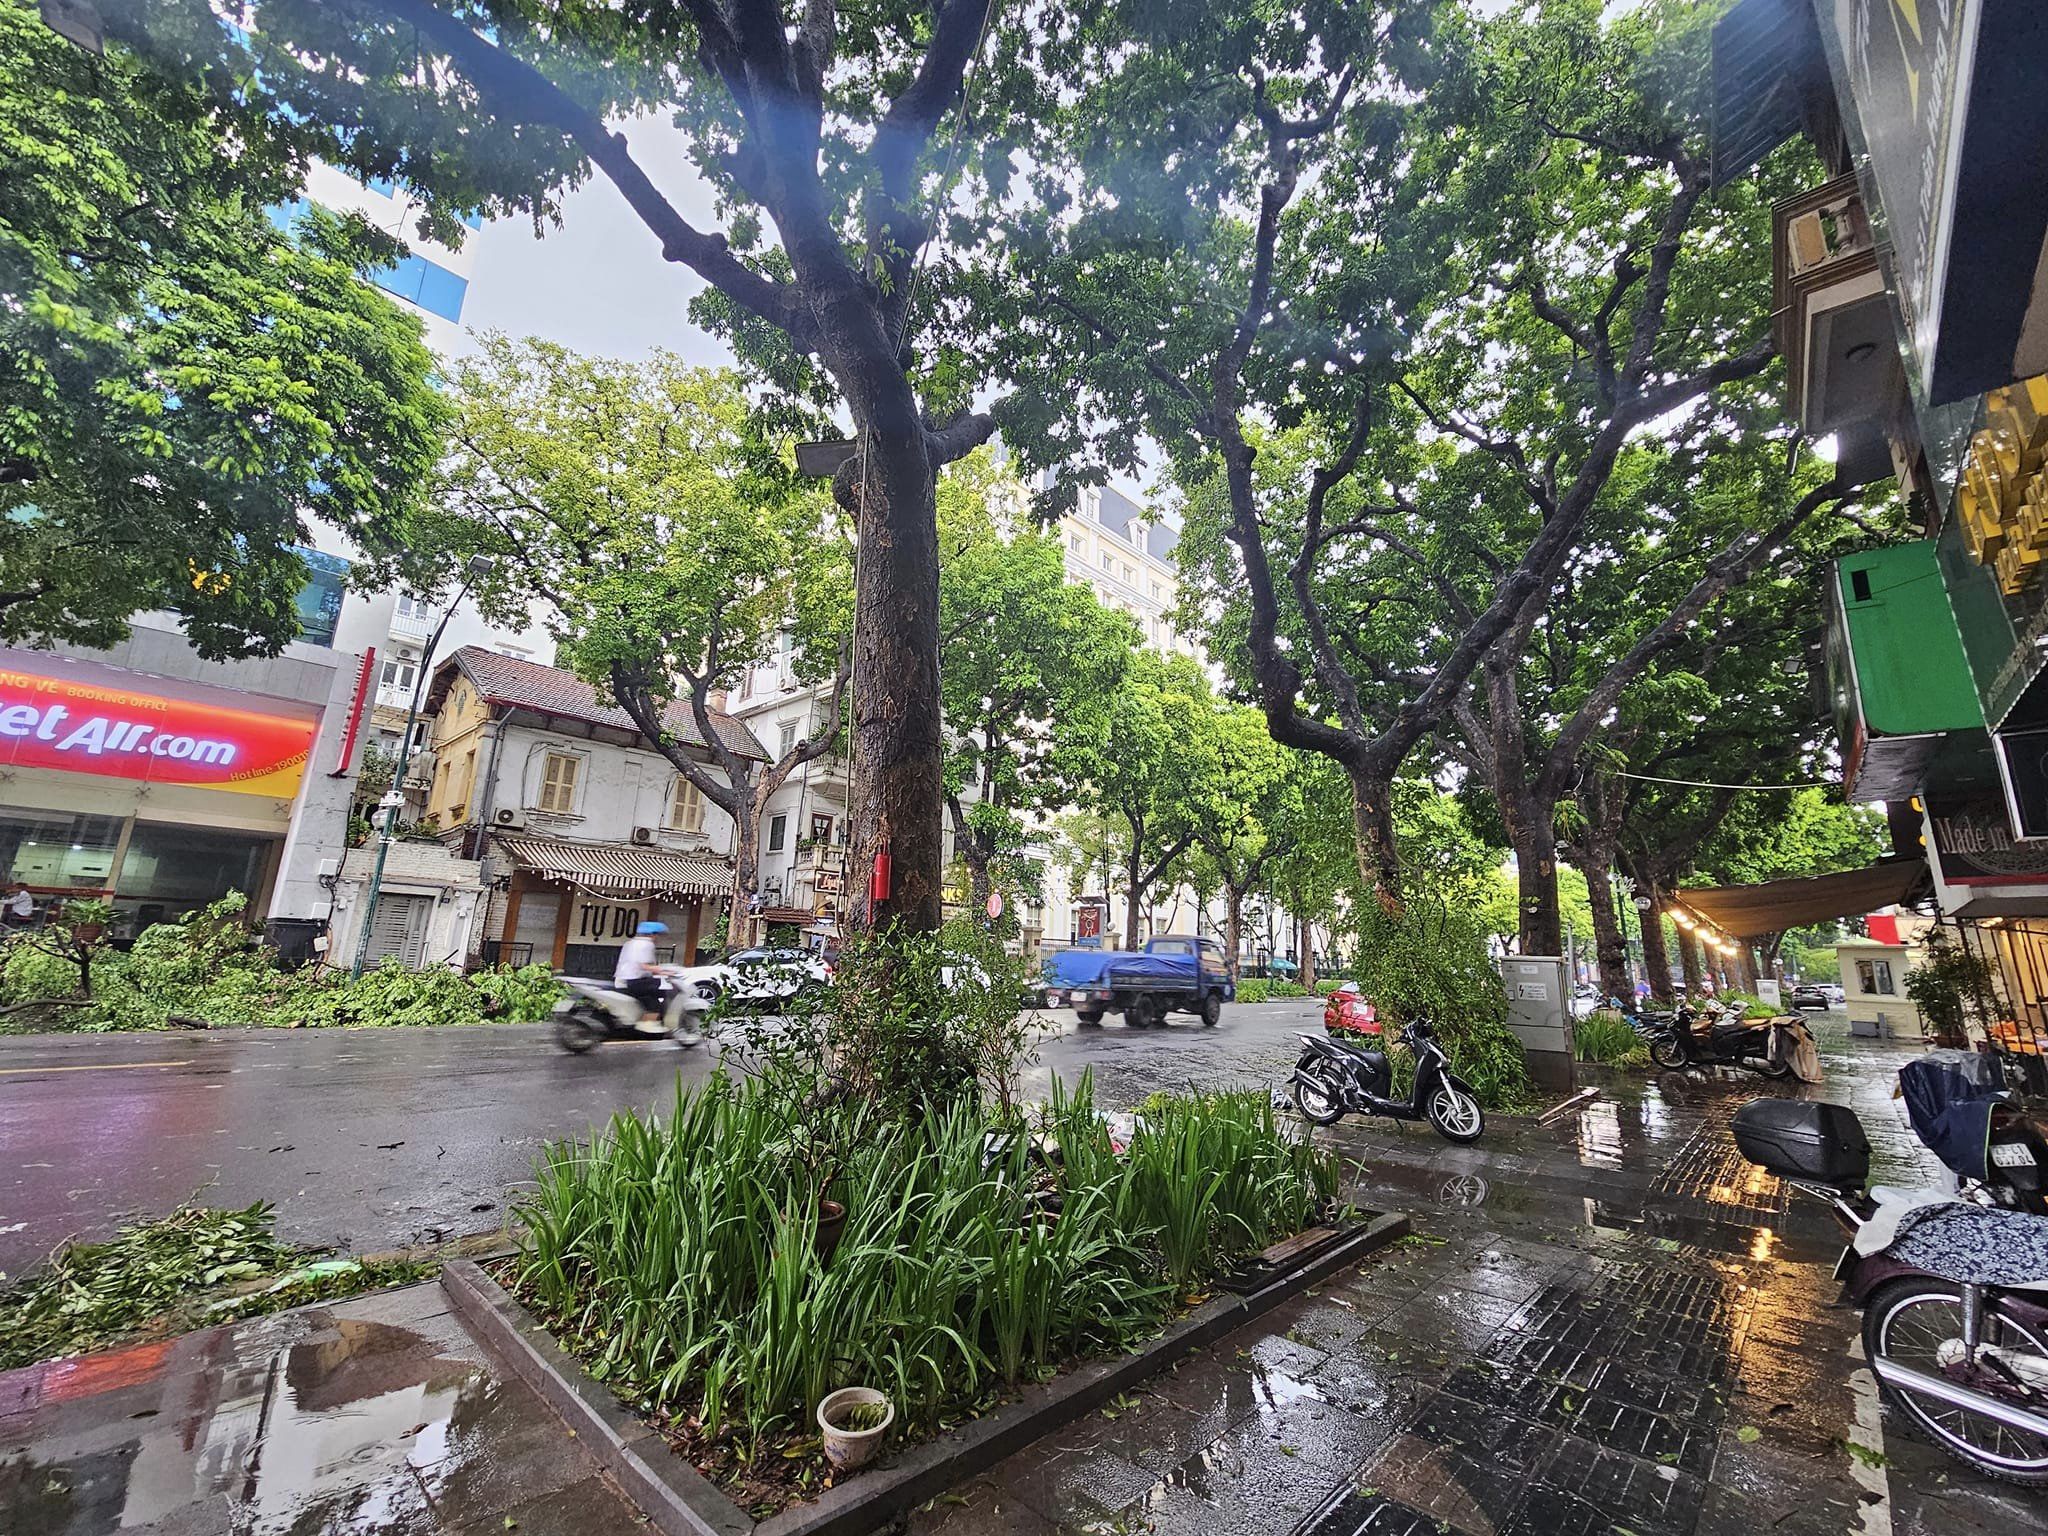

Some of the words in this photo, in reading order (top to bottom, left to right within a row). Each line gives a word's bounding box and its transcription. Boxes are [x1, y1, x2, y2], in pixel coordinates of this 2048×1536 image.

[67, 687, 126, 705] BOOKING
[130, 697, 169, 712] OFFICE
[0, 704, 69, 740] et
[230, 766, 273, 782] Hotline
[1935, 815, 1987, 855] Made
[1988, 821, 2010, 851] in
[580, 904, 610, 942] TỰ
[611, 907, 640, 938] DO
